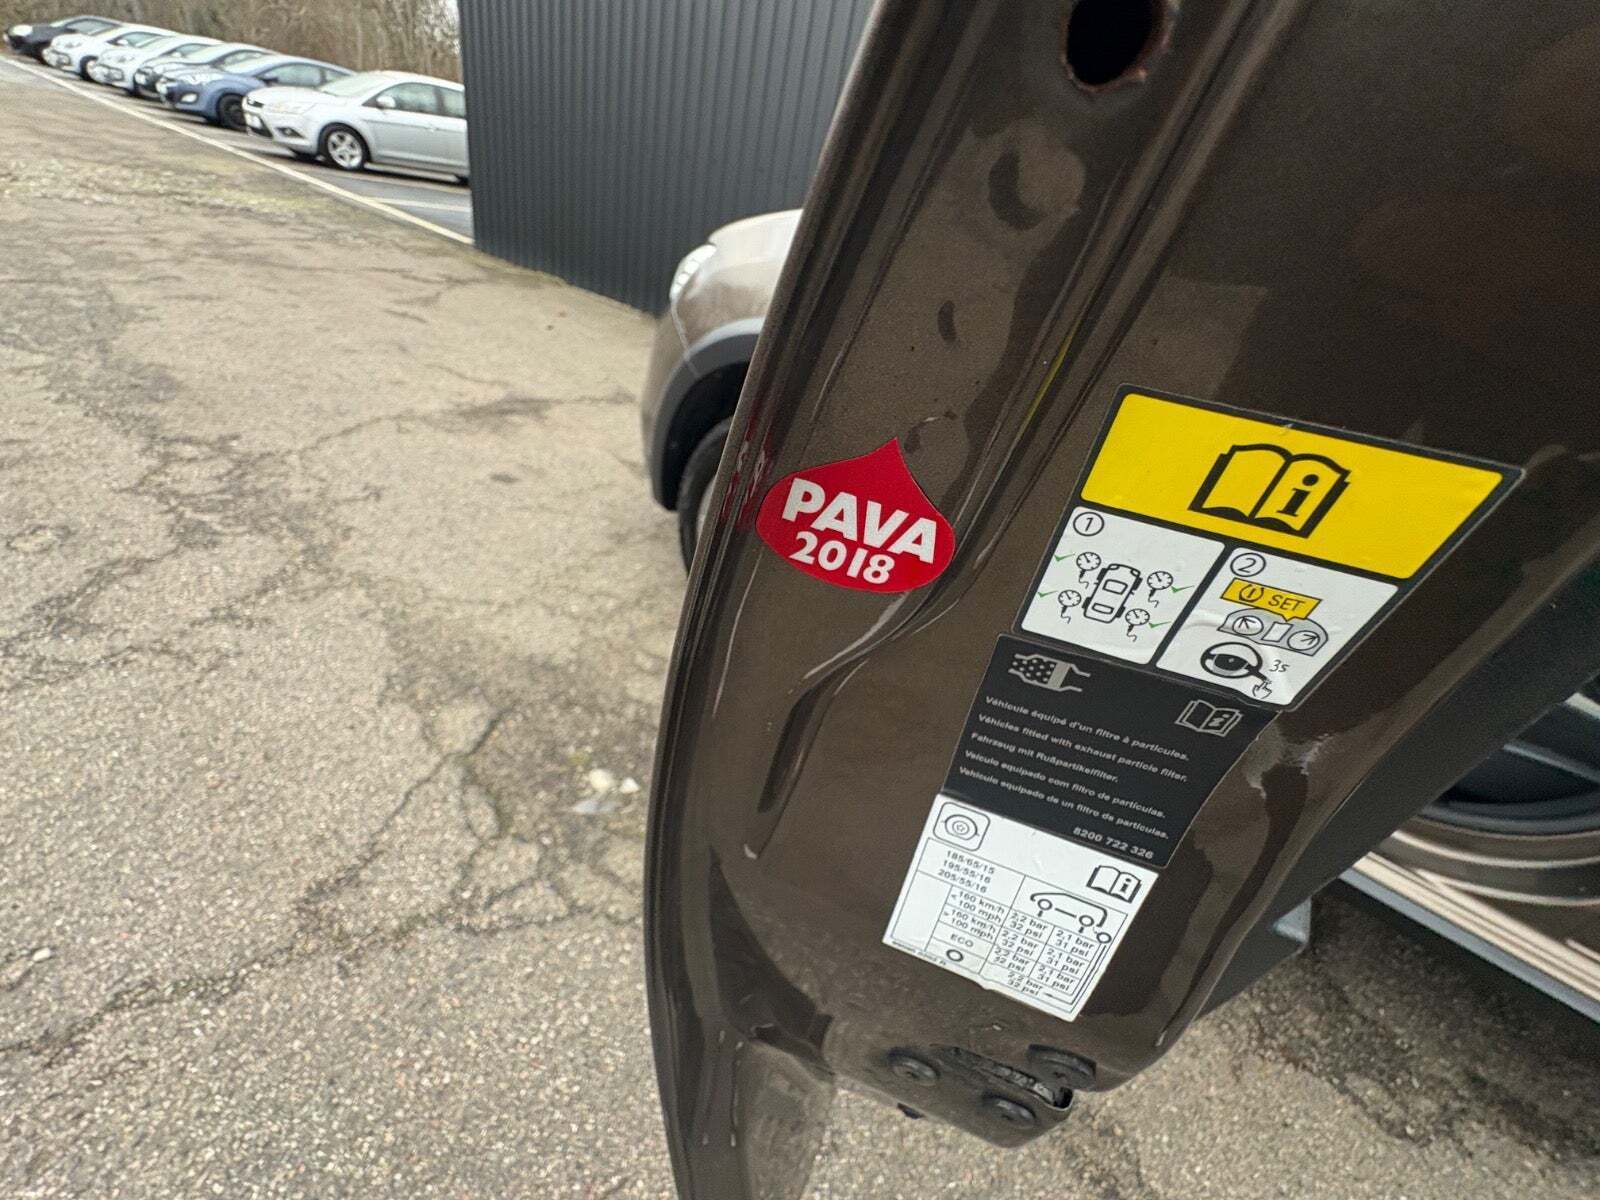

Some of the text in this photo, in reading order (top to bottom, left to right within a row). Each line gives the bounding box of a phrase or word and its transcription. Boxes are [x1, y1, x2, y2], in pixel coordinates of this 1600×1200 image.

[781, 477, 937, 564] PAVA
[788, 531, 896, 584] 2018
[1268, 594, 1305, 611] SET
[986, 696, 1029, 715] Véhicule
[1069, 721, 1093, 733] d'un
[1095, 728, 1120, 741] filtre
[1131, 740, 1189, 761] particules.
[971, 732, 1016, 752] Fahrzeug
[1017, 747, 1034, 757] mit
[1022, 727, 1050, 741] fitted
[1051, 736, 1072, 748] with
[1074, 744, 1116, 760] exhaust
[1117, 757, 1158, 773] particle
[1001, 763, 1046, 781] equipado
[1048, 777, 1070, 789] com
[1072, 783, 1096, 797] filtro
[1098, 792, 1110, 801] de
[1000, 781, 1045, 799] equipado
[1046, 795, 1060, 804] de
[1061, 799, 1074, 809] un
[1102, 813, 1114, 822] de
[1073, 827, 1154, 860] 8200 722 326
[946, 850, 996, 875] 185/65/15
[938, 869, 987, 893] 205/55/16
[978, 909, 1001, 923] mph
[979, 898, 1005, 914] km/h
[1029, 919, 1048, 930] bar
[950, 933, 974, 947] ECO
[1021, 937, 1039, 948] bar
[1075, 937, 1094, 949] bar
[1066, 955, 1085, 967] bar
